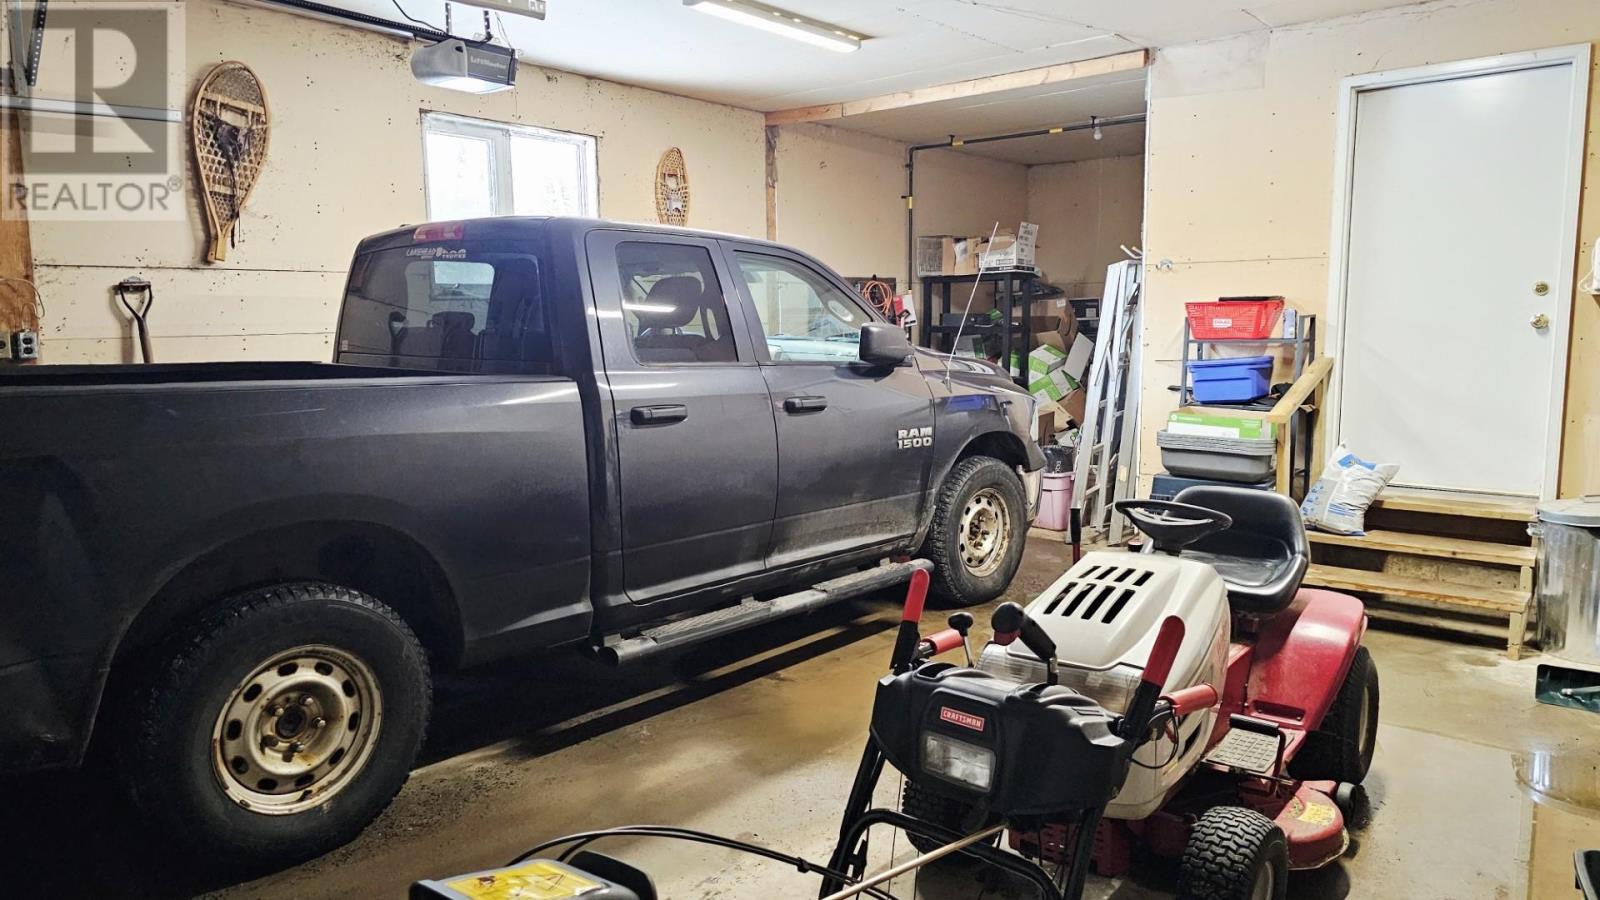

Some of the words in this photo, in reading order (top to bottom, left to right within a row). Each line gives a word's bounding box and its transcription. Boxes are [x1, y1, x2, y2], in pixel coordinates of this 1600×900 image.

[898, 426, 933, 439] RAM
[898, 437, 933, 449] 1500
[943, 710, 982, 728] CRAFTSMAN
